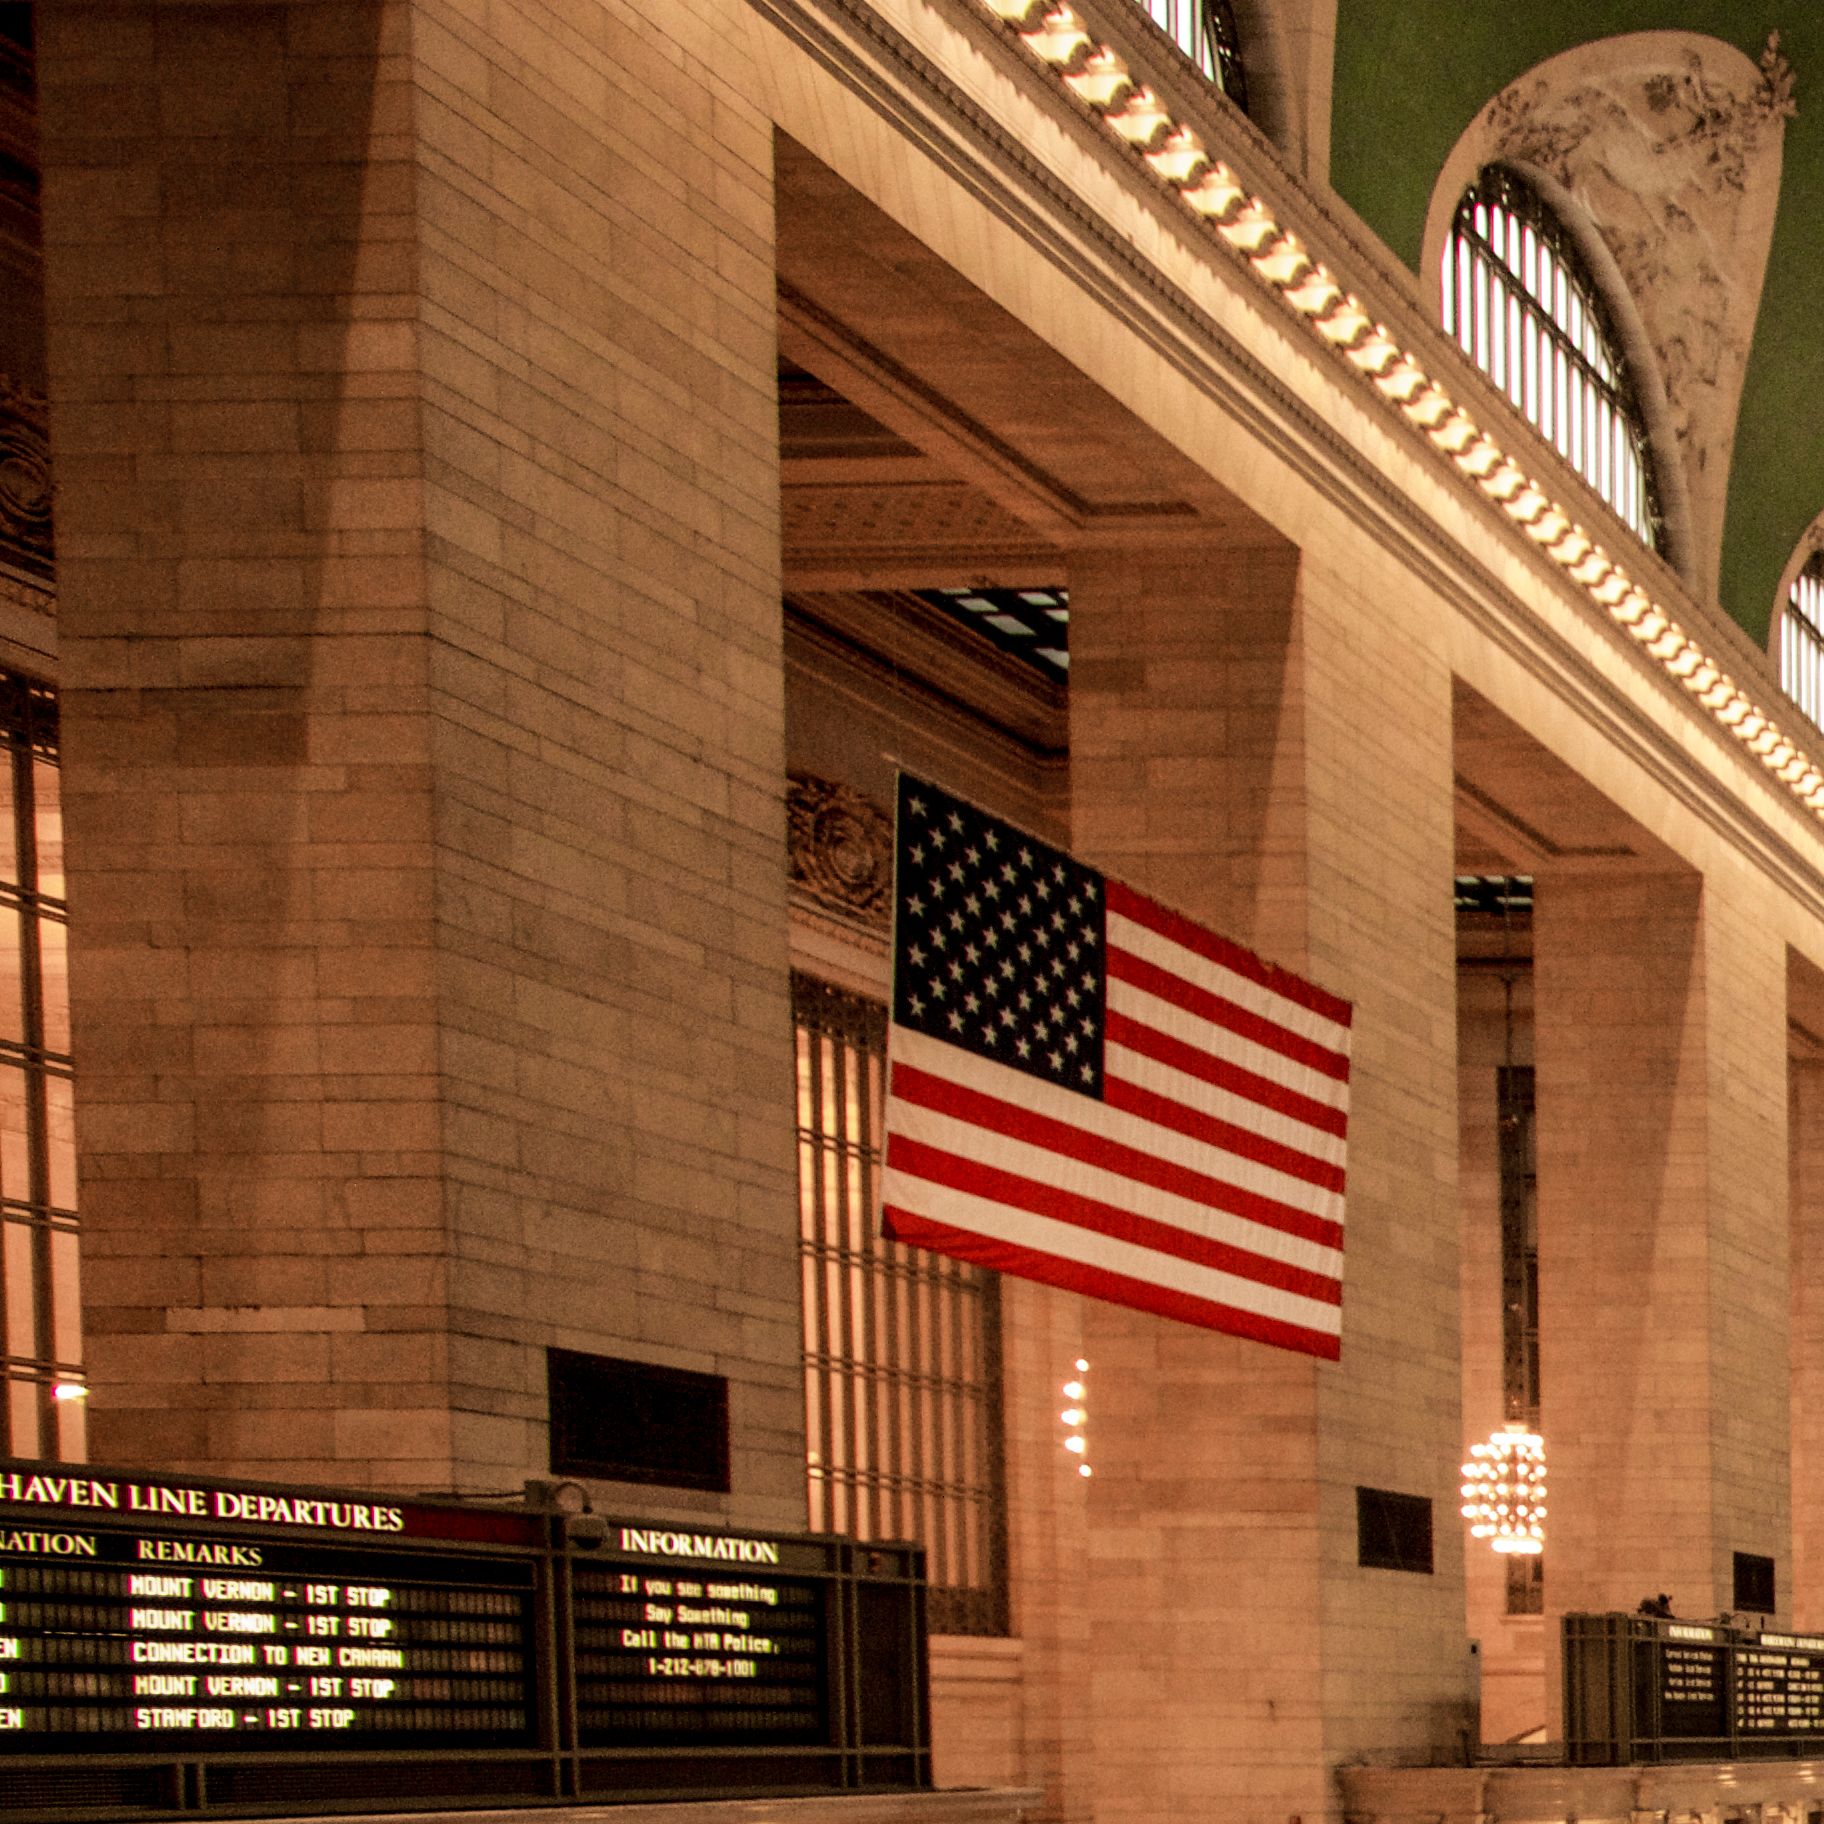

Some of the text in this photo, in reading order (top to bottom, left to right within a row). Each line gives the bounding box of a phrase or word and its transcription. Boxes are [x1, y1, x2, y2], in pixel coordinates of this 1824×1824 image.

[0, 1473, 404, 1532] HAVEN LINE DEPARTURES
[0, 1531, 97, 1556] ATION
[137, 1539, 263, 1567] REMARKS
[621, 1528, 779, 1564] INFORMATION
[129, 1574, 192, 1598] MOUNT
[202, 1579, 275, 1601] VERNON
[305, 1584, 338, 1605] 1ST
[345, 1586, 391, 1607] STOP
[645, 1579, 672, 1597] you
[707, 1583, 778, 1606] something
[131, 1608, 195, 1630] MOUNT
[203, 1611, 276, 1633] VERNON
[306, 1615, 339, 1635] 1ST
[347, 1617, 393, 1637] STOP
[646, 1603, 750, 1629] Say Something
[622, 1629, 656, 1648] Call
[664, 1630, 690, 1649] the
[132, 1642, 404, 1668] CONNECTION TO NEW CANAAN
[133, 1675, 197, 1696] MOUNT
[206, 1676, 279, 1696] VERNON
[310, 1677, 343, 1696] 1ST
[350, 1678, 396, 1698] STOP
[135, 1708, 234, 1729] STAMFORD
[267, 1709, 301, 1728] 1ST
[308, 1709, 354, 1728] STOP
